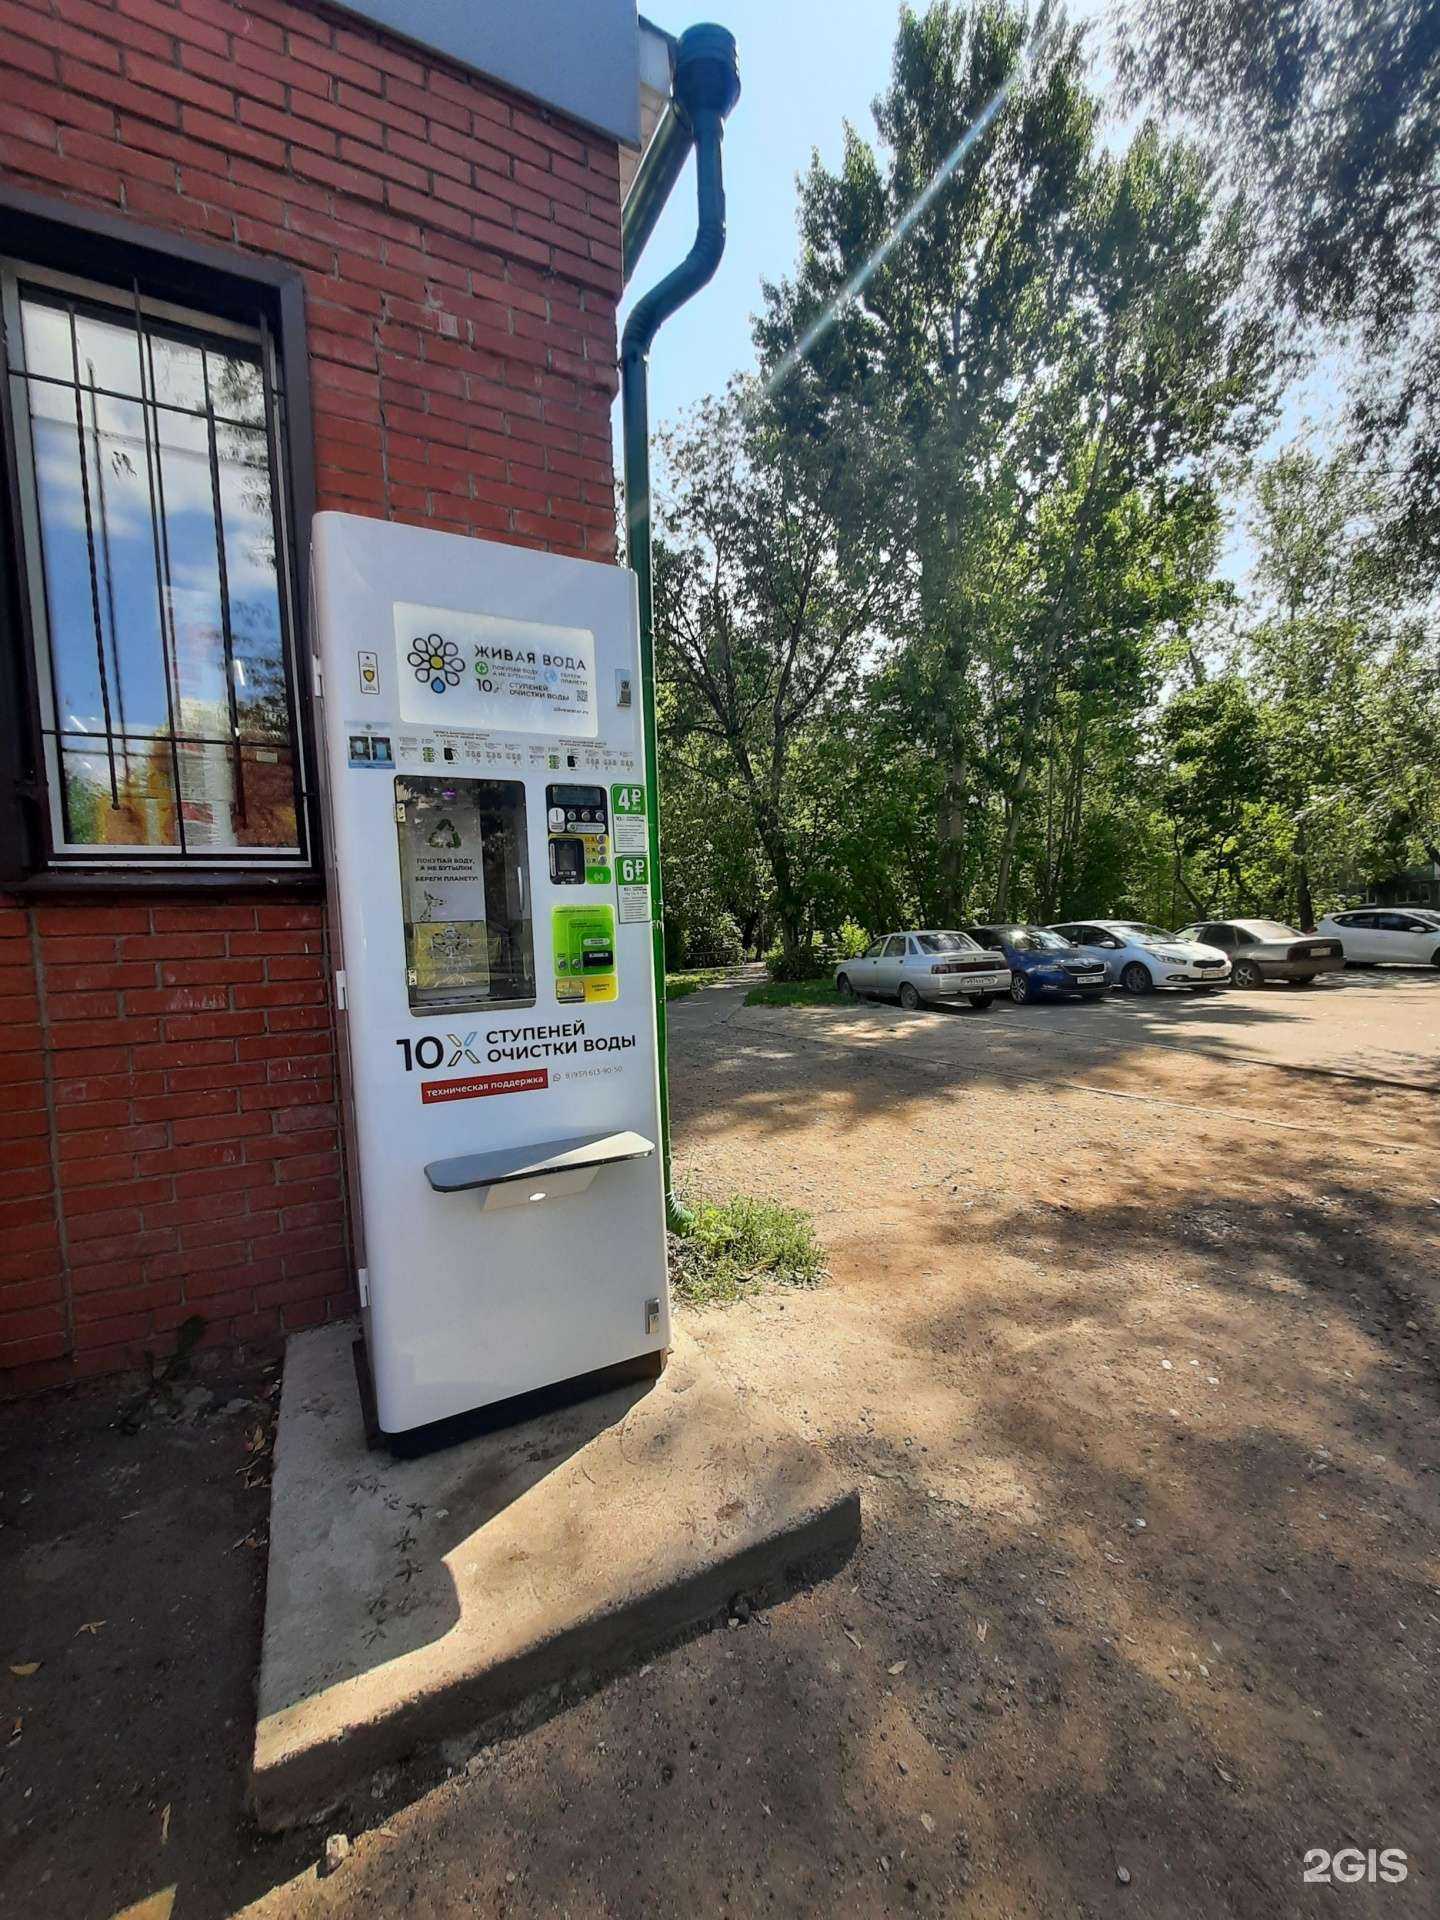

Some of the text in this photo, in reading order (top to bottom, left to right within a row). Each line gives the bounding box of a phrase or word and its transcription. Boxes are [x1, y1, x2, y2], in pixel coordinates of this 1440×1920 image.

[474, 644, 586, 670] ЖИВАЯ ВОДА
[509, 681, 549, 692] СТУПЕНЕЙ
[509, 689, 570, 701] ОЧИСТКИ ВОДЫ
[486, 1019, 586, 1044] СТУПЕНЕЙ
[487, 1034, 636, 1063] ОЧИСТКИ ВОДЫ
[427, 1075, 544, 1098] техническая поддержка
